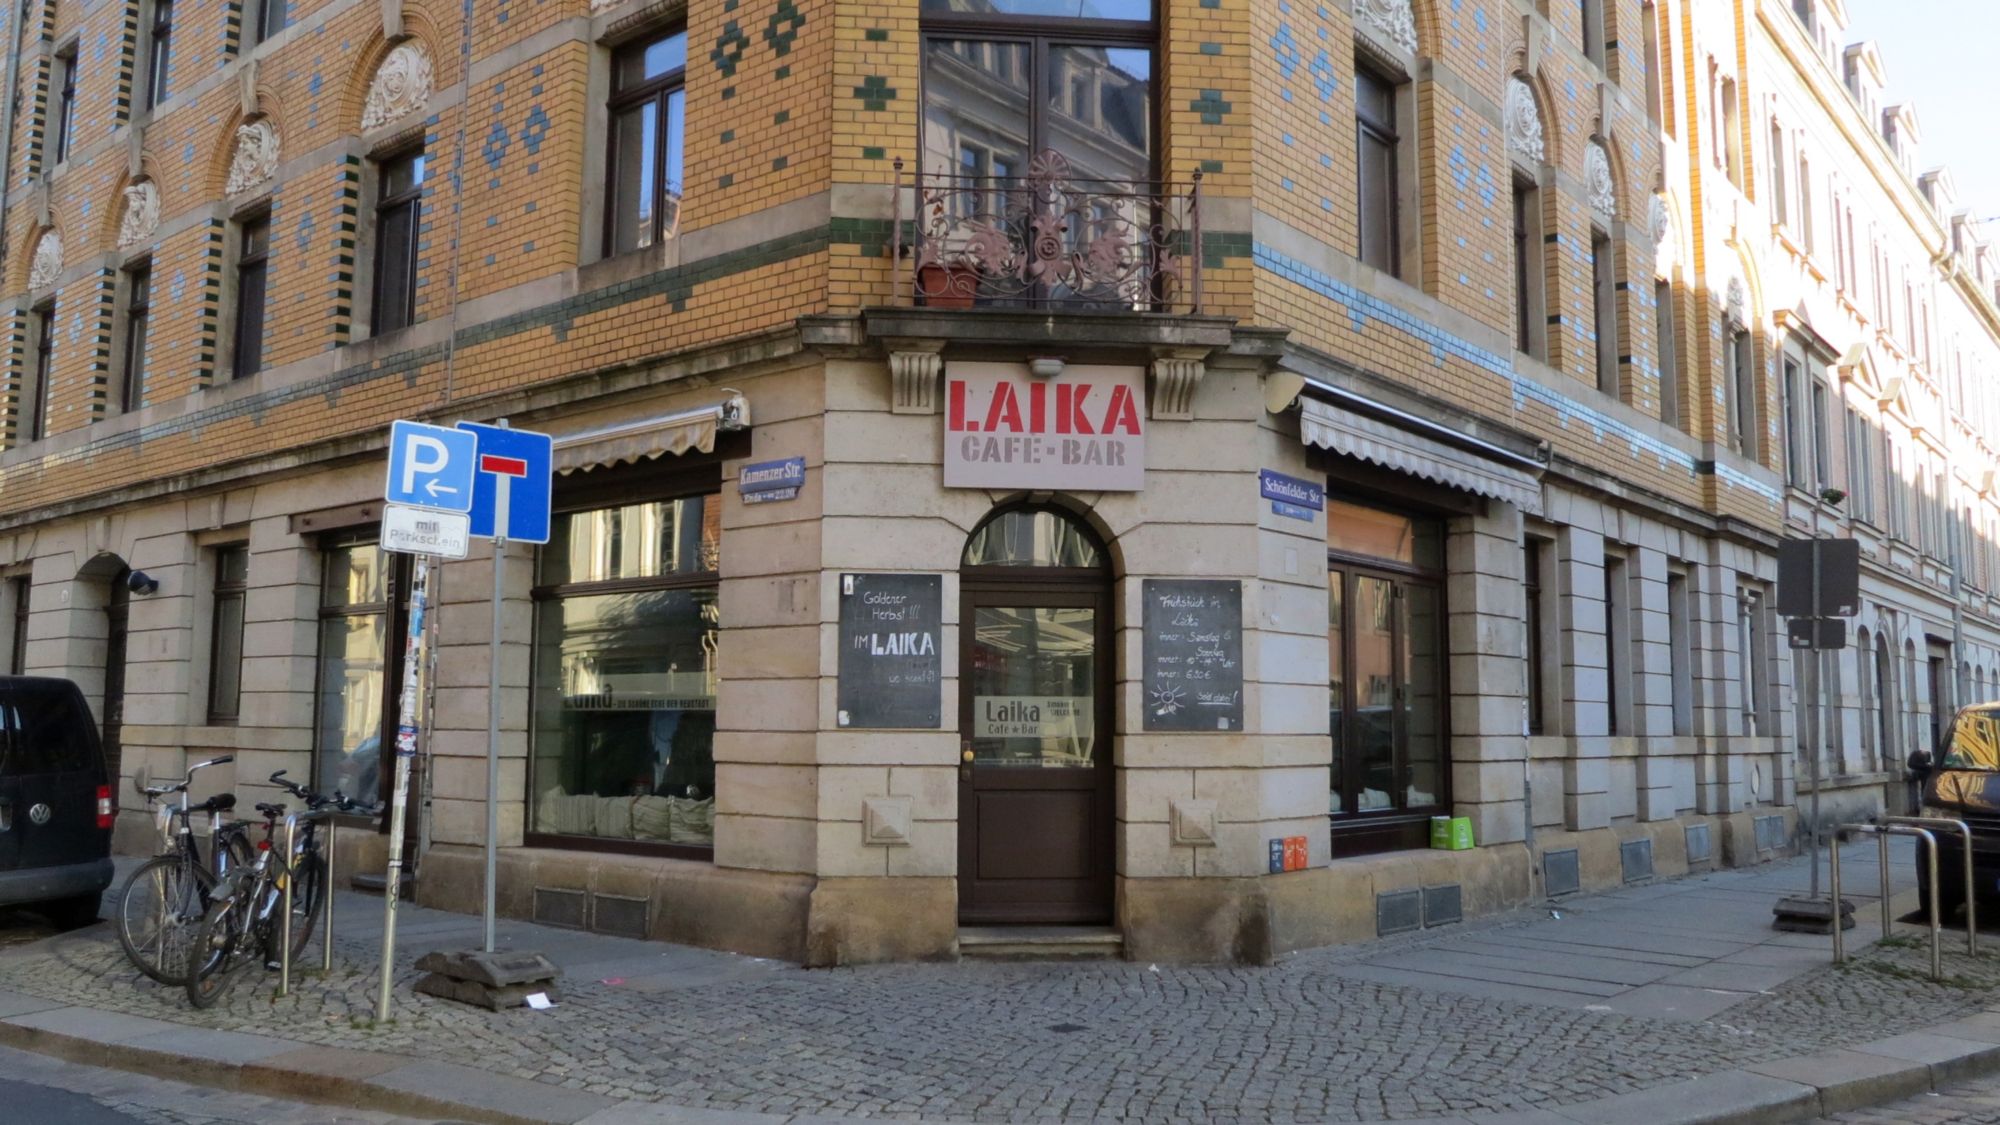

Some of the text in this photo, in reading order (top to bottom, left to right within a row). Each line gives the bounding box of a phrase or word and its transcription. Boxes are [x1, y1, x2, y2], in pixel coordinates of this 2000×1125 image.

[950, 381, 1141, 435] LAIKA
[402, 434, 449, 494] P
[740, 461, 801, 485] Kamenzer Str.
[1265, 477, 1308, 500] Schönfelder
[863, 591, 907, 604] Goldener
[871, 632, 935, 656] LAIKA
[986, 700, 1040, 722] Laika
